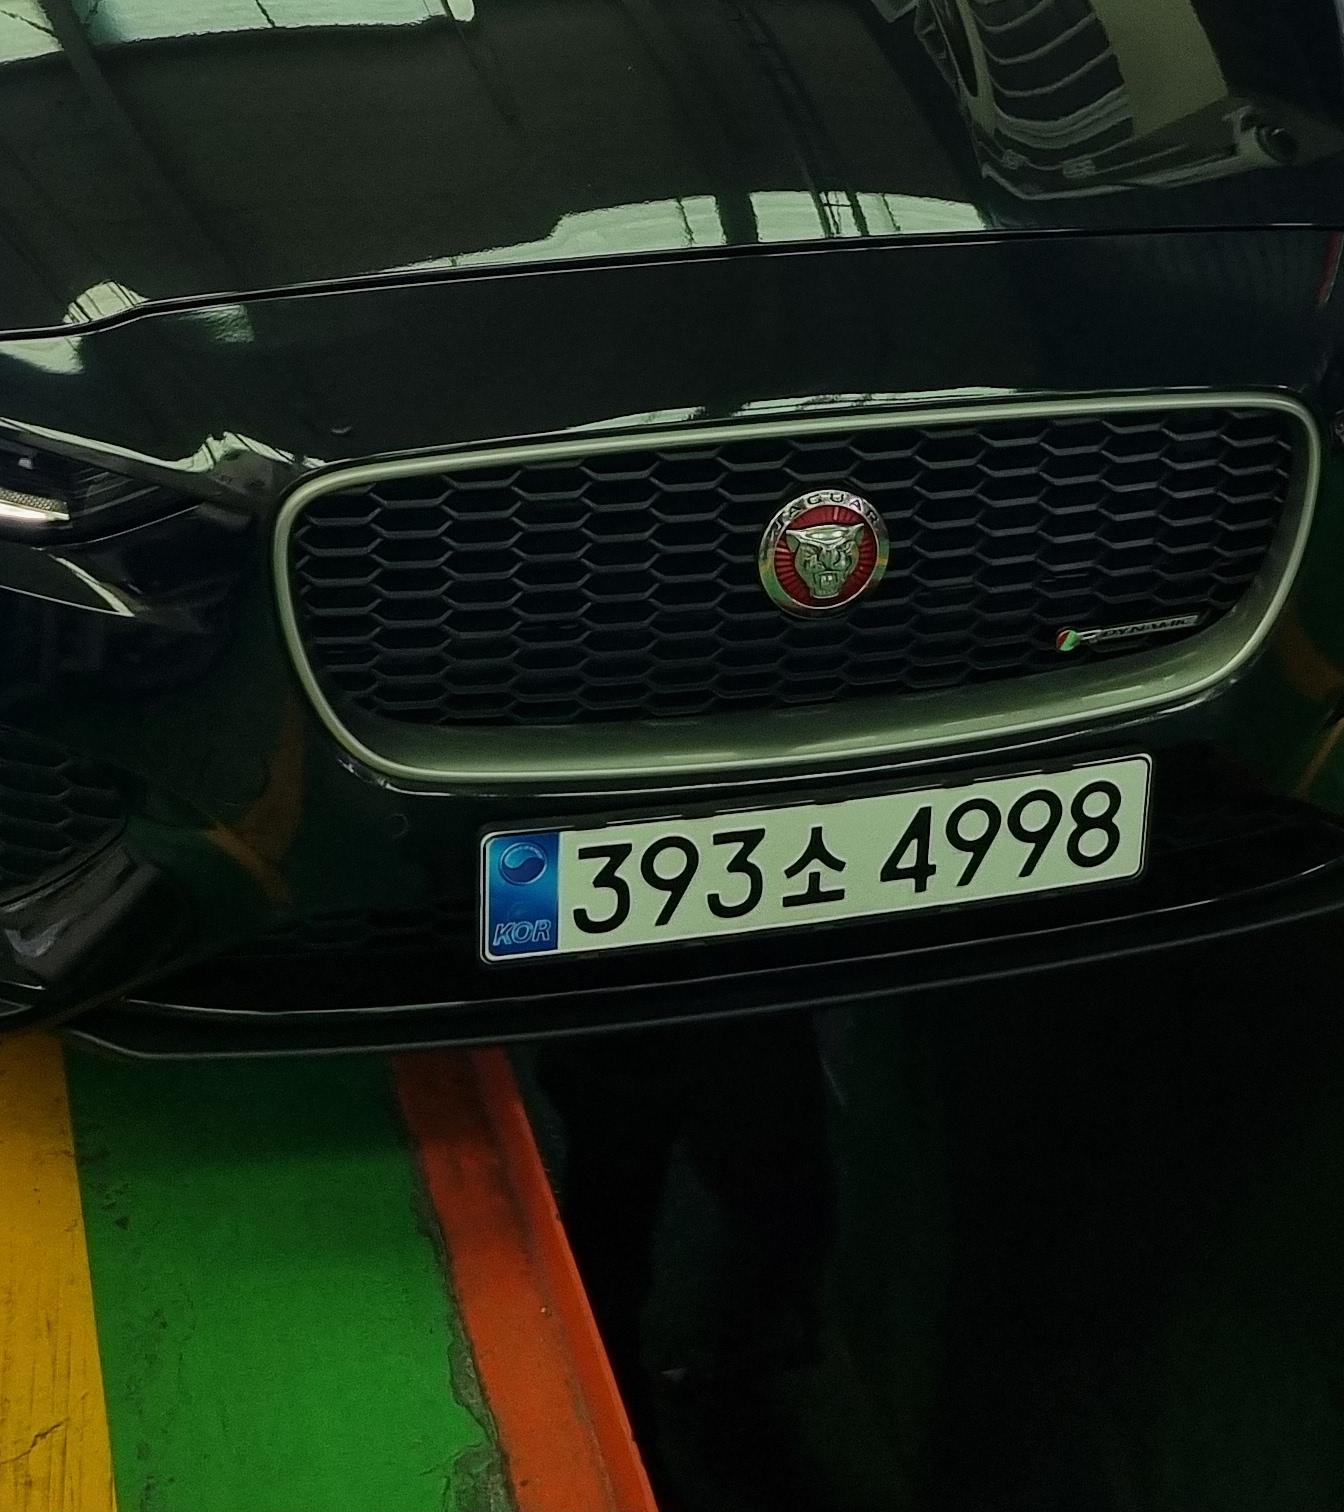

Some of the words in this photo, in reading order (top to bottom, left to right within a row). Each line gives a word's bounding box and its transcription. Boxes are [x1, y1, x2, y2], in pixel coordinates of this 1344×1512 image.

[772, 491, 880, 531] JAGUAR
[573, 825, 847, 935] 393소
[880, 780, 1123, 893] 4998
[492, 918, 552, 945] KOR
